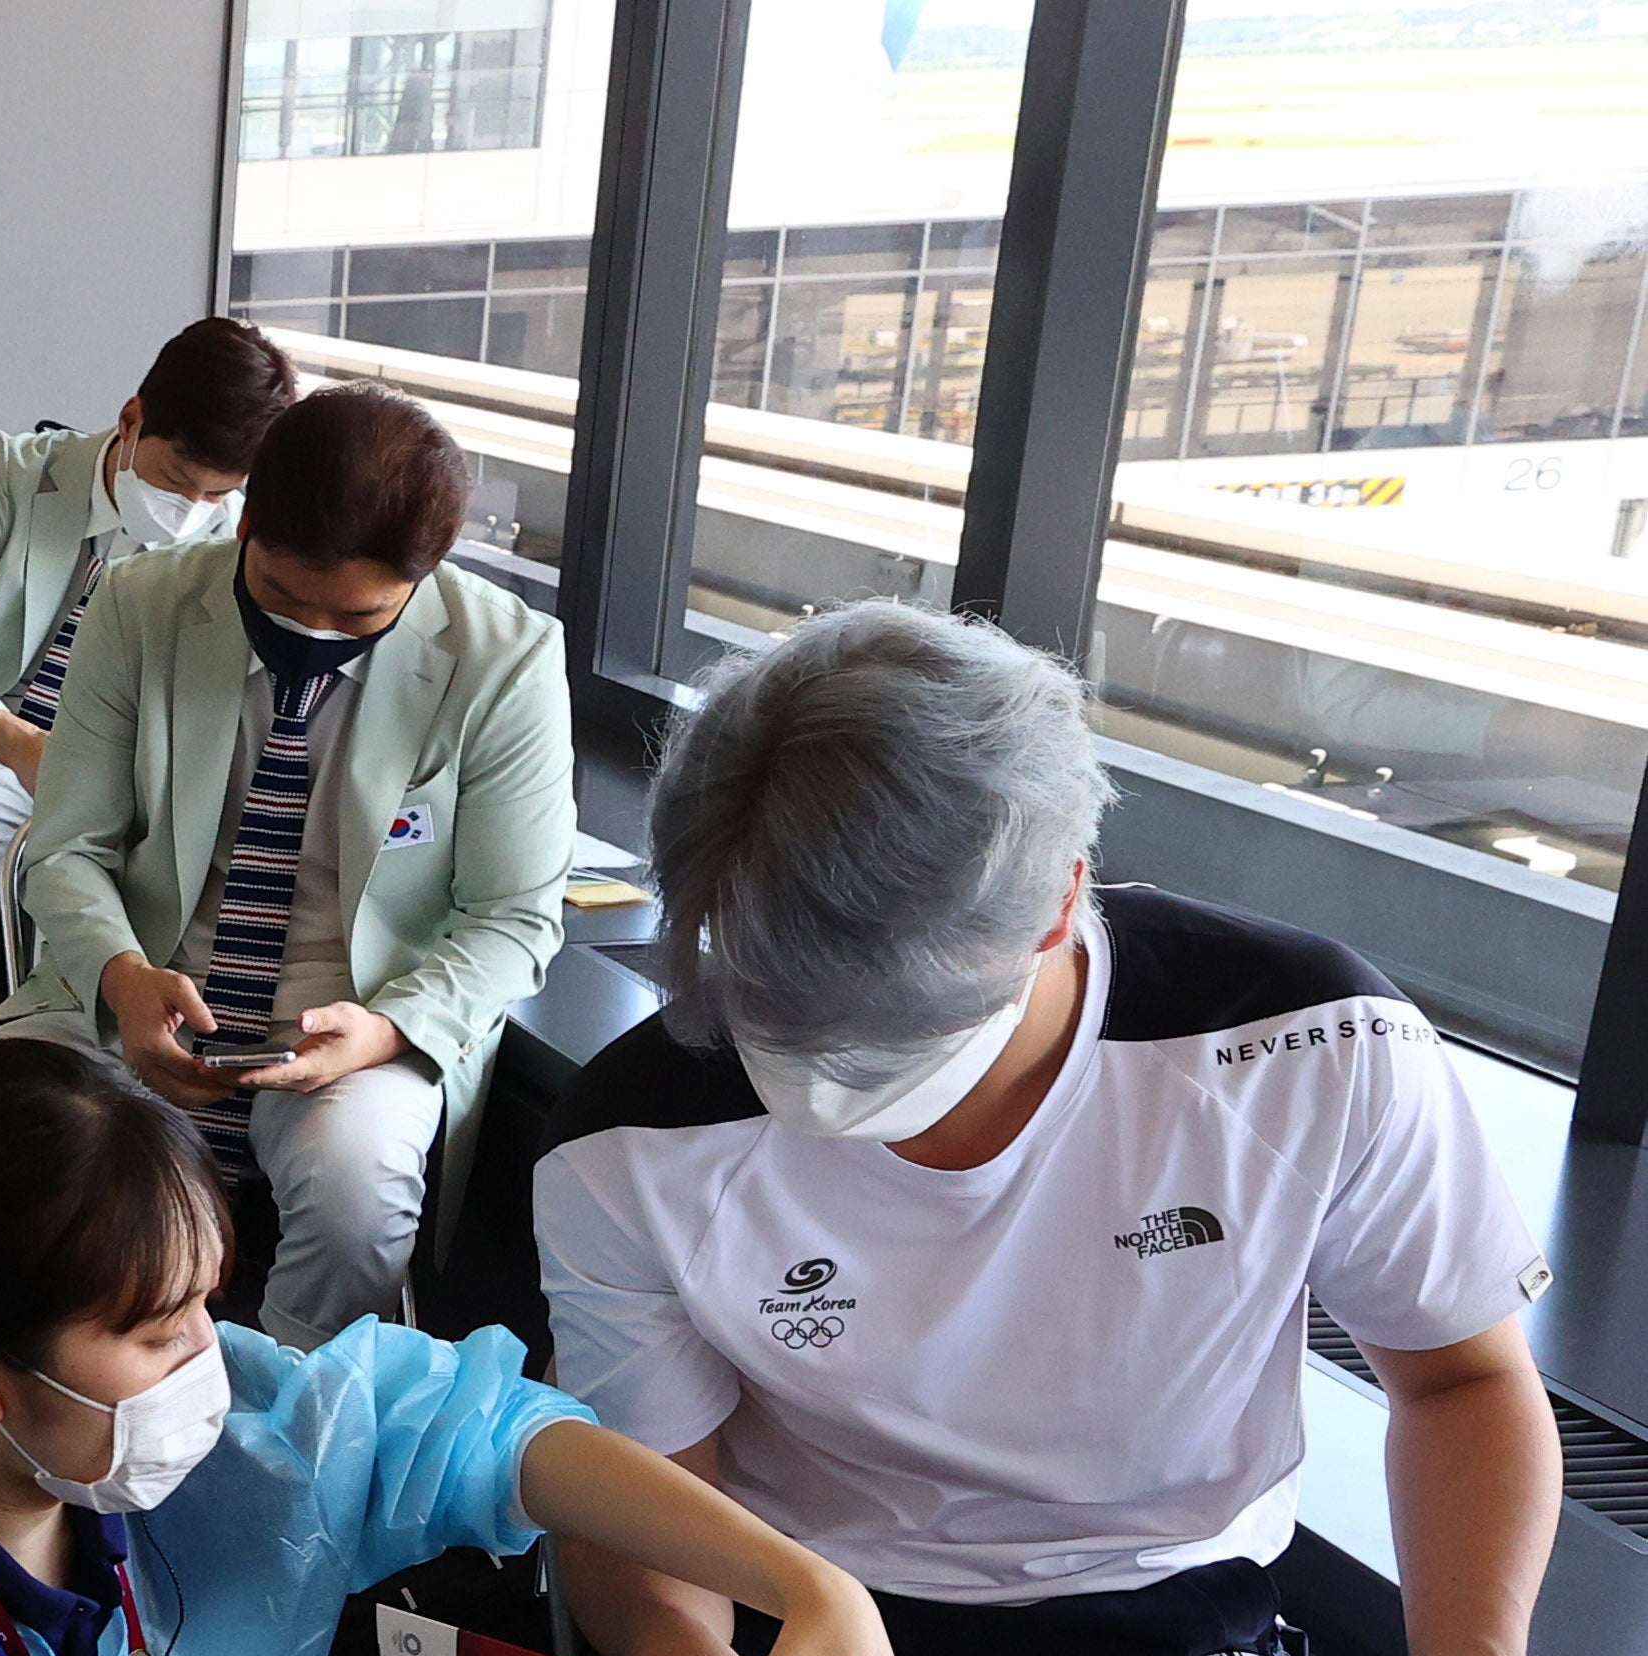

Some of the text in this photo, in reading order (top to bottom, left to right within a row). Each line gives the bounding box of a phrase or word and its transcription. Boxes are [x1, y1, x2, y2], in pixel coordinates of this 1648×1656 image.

[1504, 456, 1563, 492] 26
[1216, 1026, 1328, 1067] NEVER
[1140, 1208, 1180, 1230] THE
[1113, 1222, 1184, 1250] NORTH
[1137, 1235, 1187, 1260] FACE
[758, 1293, 857, 1316] Team Korea
